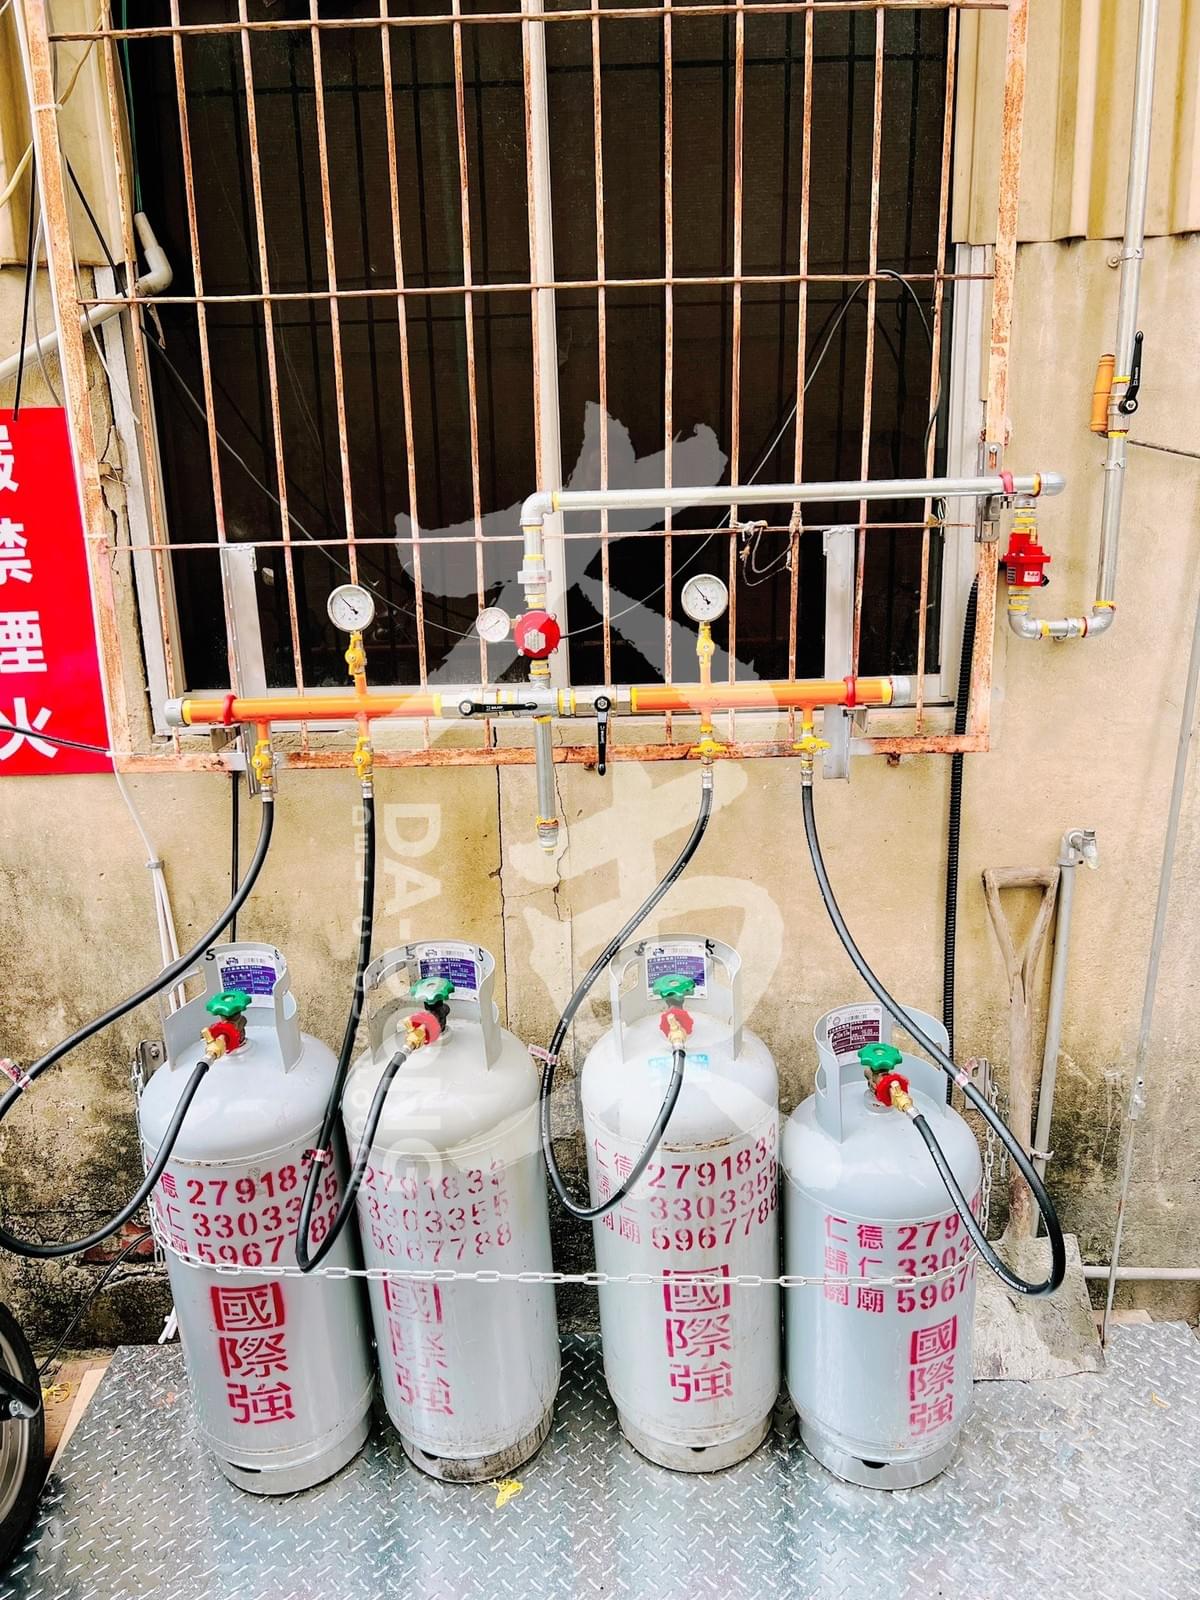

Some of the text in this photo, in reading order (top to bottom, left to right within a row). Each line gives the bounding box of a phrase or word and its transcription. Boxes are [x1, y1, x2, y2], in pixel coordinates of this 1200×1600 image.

[205, 949, 216, 961] 5
[211, 1281, 296, 1425] 國際強
[662, 1264, 734, 1403] 國際強
[910, 1314, 958, 1437] 國際強
